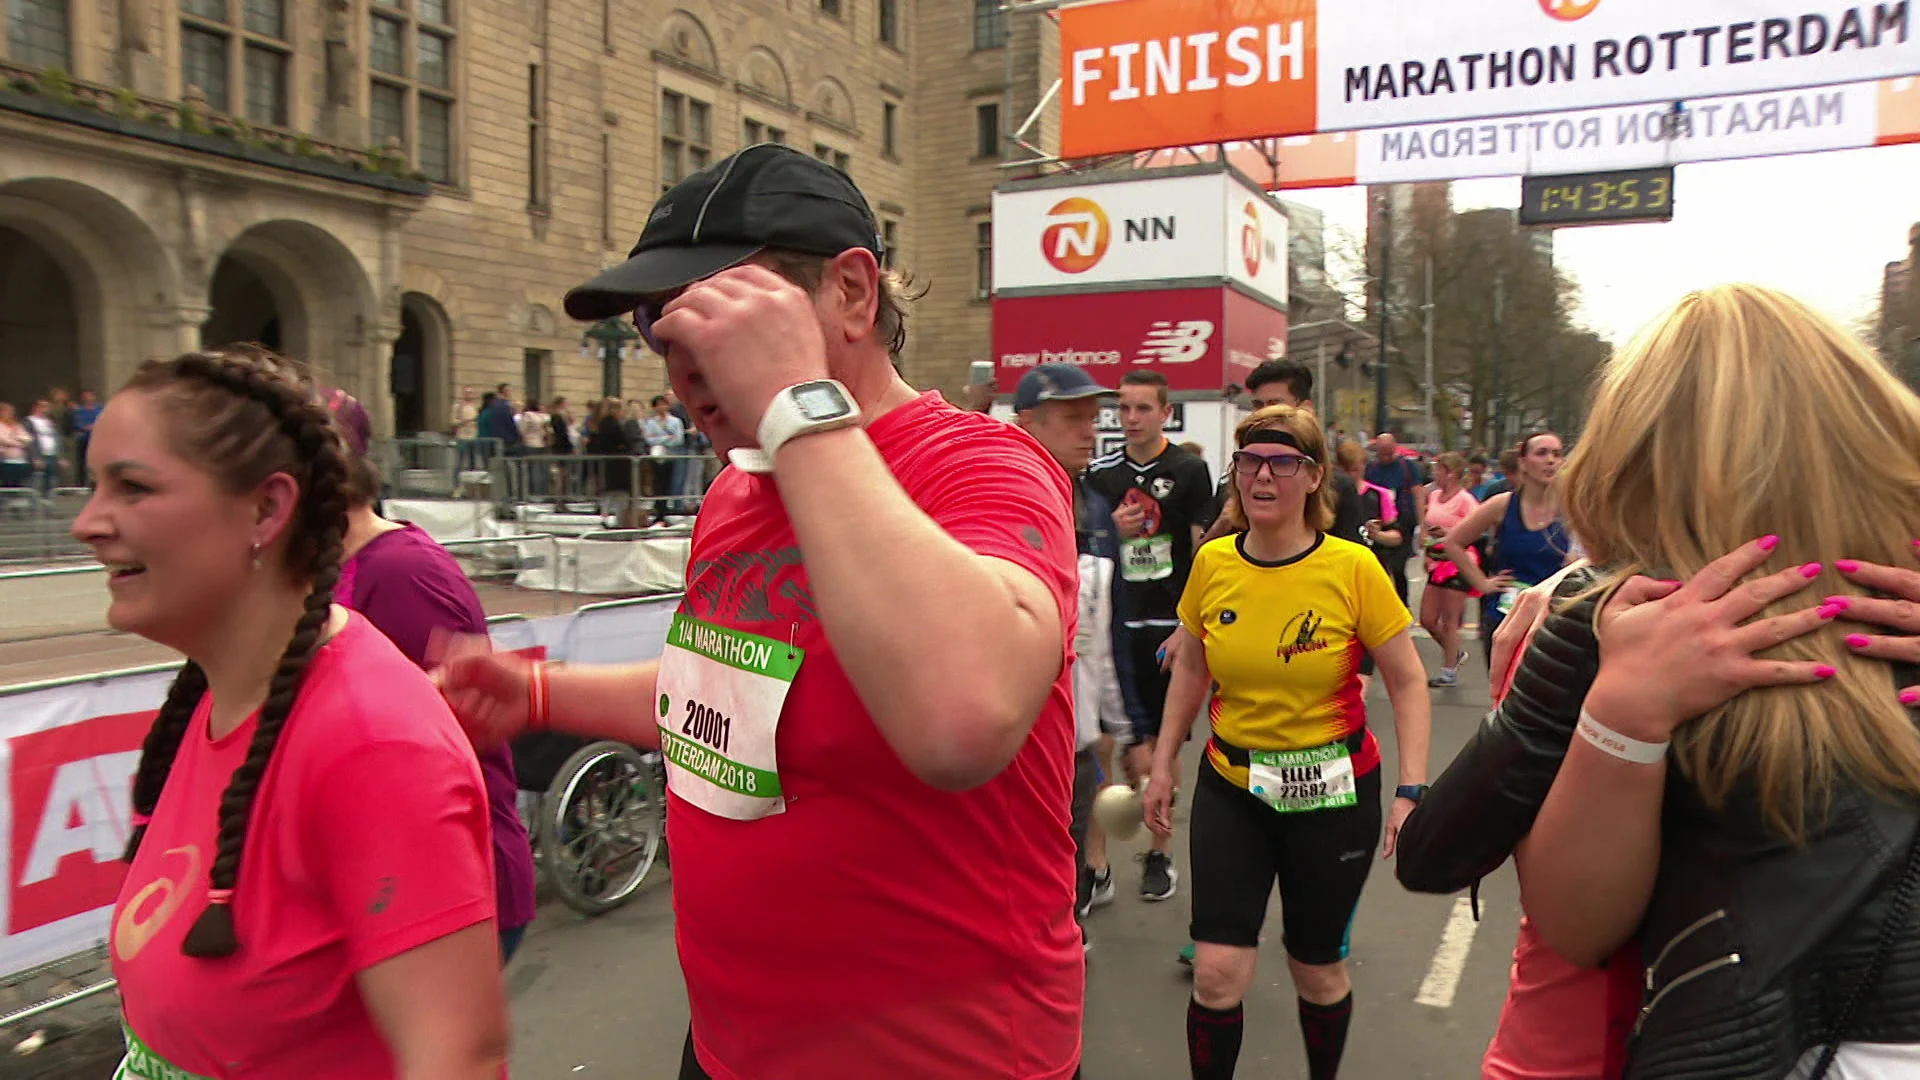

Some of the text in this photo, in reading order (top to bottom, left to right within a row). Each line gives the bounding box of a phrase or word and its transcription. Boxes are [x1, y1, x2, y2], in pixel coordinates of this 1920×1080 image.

[1071, 20, 1304, 106] FINISH
[1344, 1, 1910, 103] MARATHON ROTTERDAM
[1540, 177, 1671, 212] 1:43:53
[1123, 215, 1176, 242] NN
[1001, 348, 1121, 369] new balance
[679, 620, 773, 670] 1/4 MARATHON
[682, 699, 731, 753] 20001
[719, 761, 757, 793] 2018
[1281, 764, 1322, 784] ELLEN
